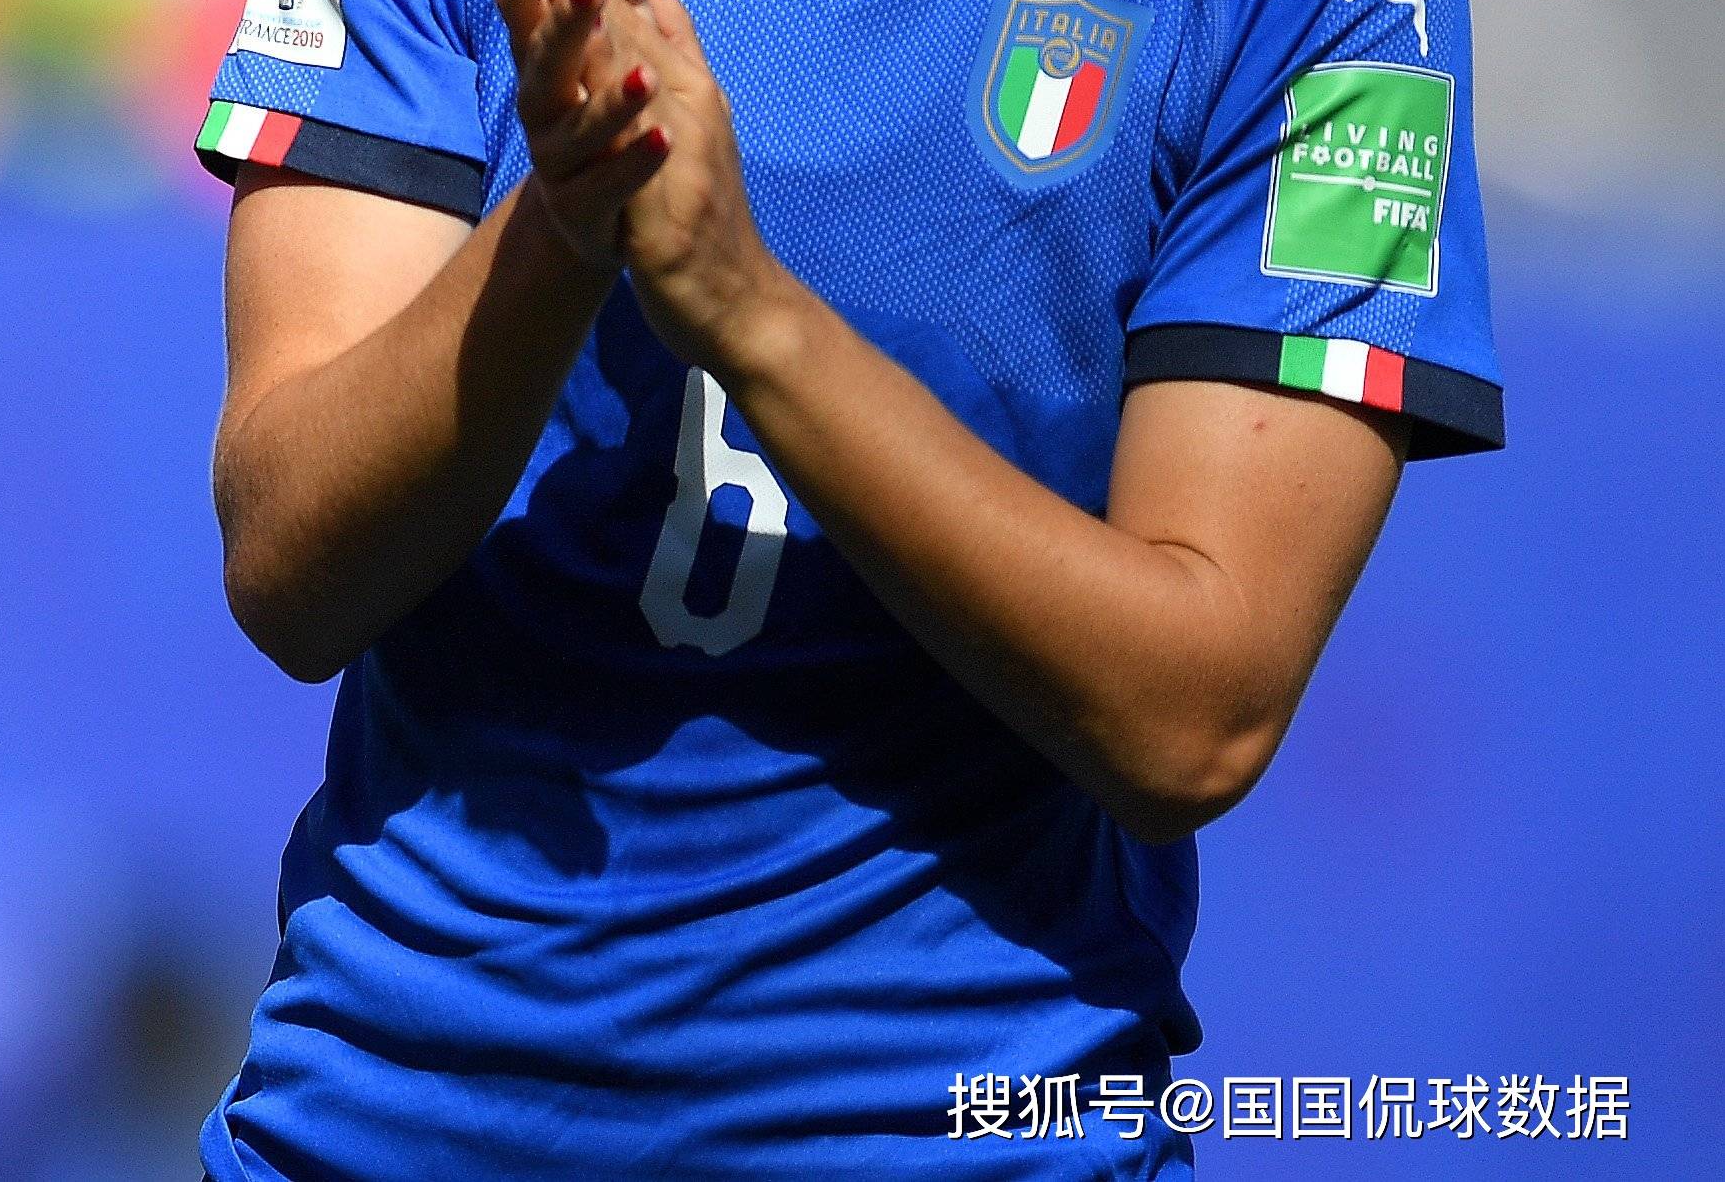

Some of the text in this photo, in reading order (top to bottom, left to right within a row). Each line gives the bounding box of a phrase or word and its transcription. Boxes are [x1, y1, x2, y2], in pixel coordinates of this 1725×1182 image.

[239, 18, 291, 45] RANCE
[292, 29, 324, 49] 2019
[1019, 10, 1118, 52] ITALIA
[1292, 142, 1434, 182] FOOTBALL
[1373, 197, 1429, 232] FIFA
[639, 367, 788, 657] 6
